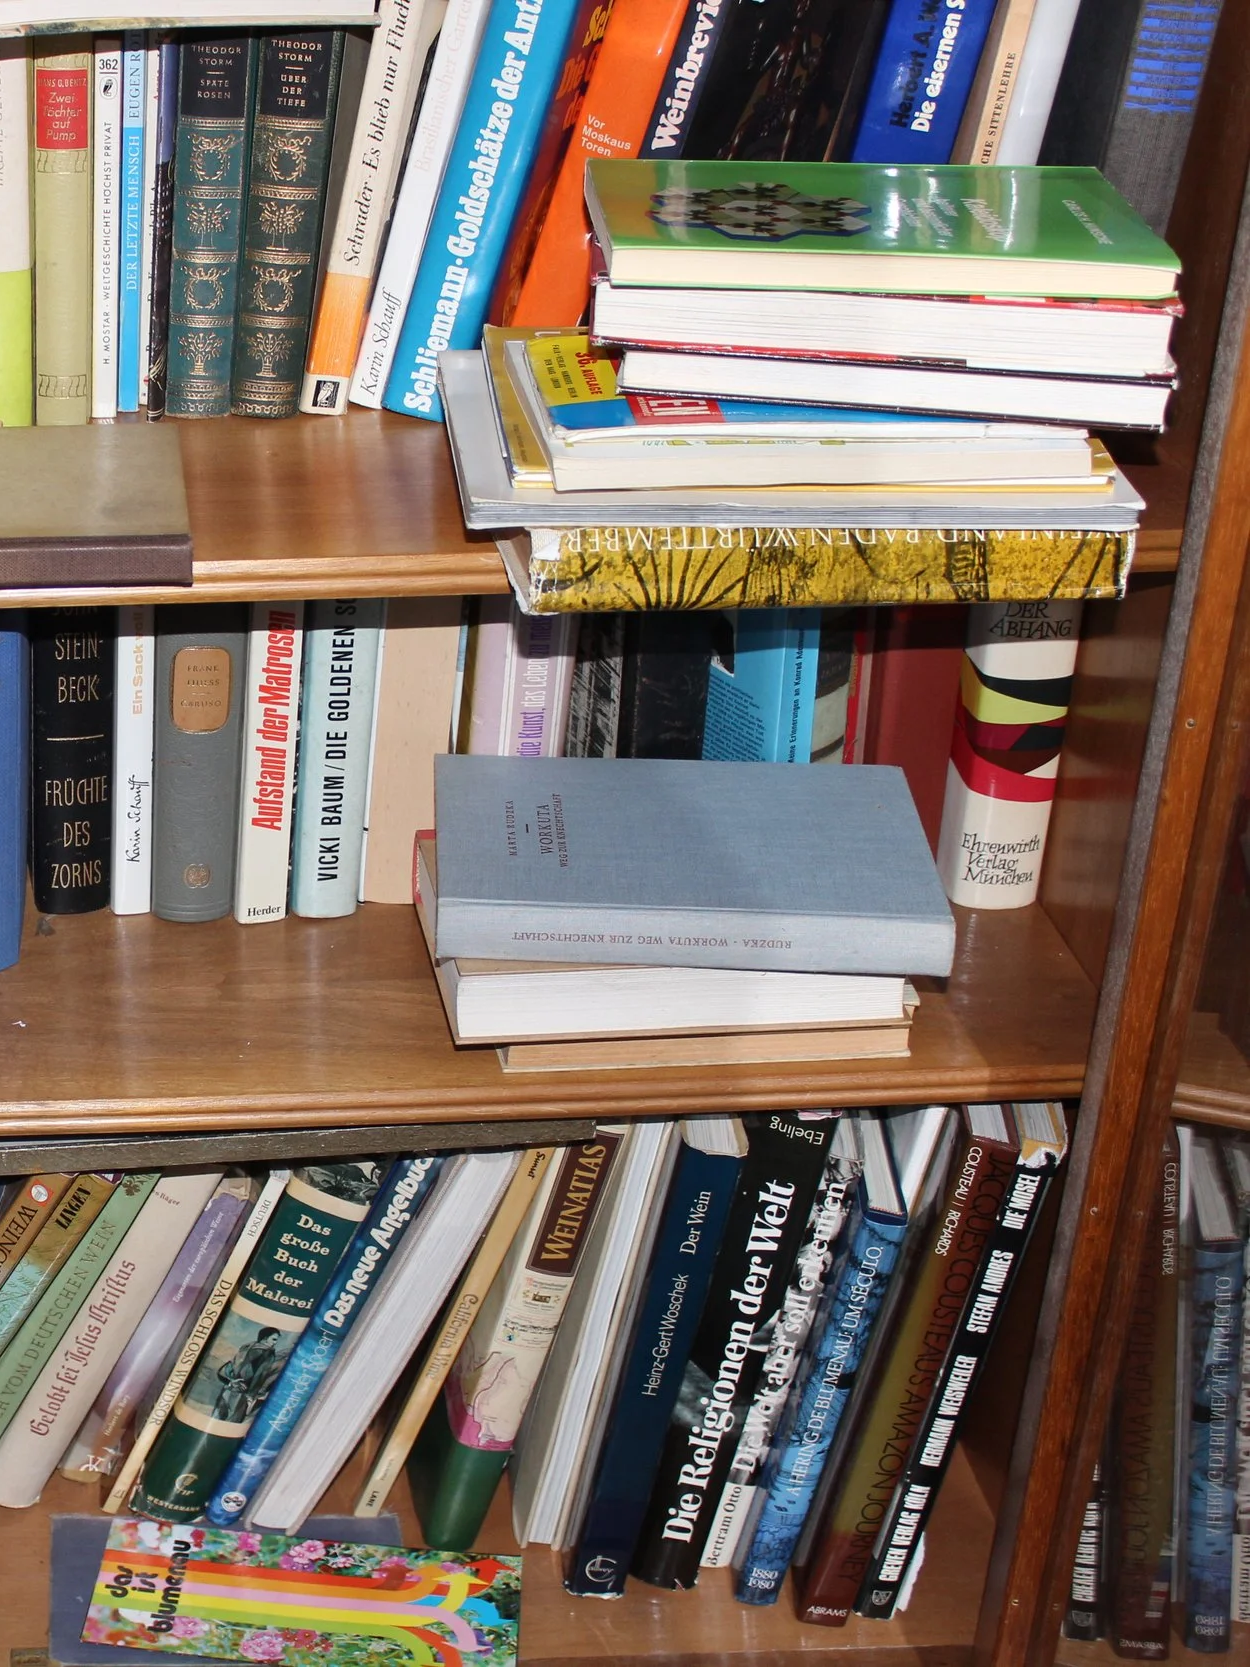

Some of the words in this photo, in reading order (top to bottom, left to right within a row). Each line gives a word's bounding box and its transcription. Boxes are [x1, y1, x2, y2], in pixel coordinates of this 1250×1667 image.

[191, 45, 242, 55] THEODOR
[271, 40, 322, 51] THEODOR
[278, 52, 312, 63] STORM
[99, 59, 118, 70] 362
[199, 57, 234, 66] STORM
[911, 101, 936, 133] Die
[925, 18, 958, 98] eisernen
[128, 67, 141, 119] EUGEN
[200, 77, 230, 88] SPÄTE
[280, 73, 307, 84] ÜBER
[282, 85, 302, 95] DER
[197, 90, 231, 99] ROSEN
[276, 97, 306, 107] TIEFE
[46, 130, 77, 142] Pump
[588, 115, 605, 130] Vor
[104, 122, 112, 156] PRIVAT
[581, 137, 611, 157] Toren
[582, 127, 631, 150] Moskaus
[128, 135, 140, 197] MENSCH
[104, 160, 112, 204] HÖCHST
[126, 201, 140, 257] LETZTE
[103, 207, 112, 300] WELTGESCHICHTE
[126, 260, 138, 291] DER
[103, 311, 111, 352] MOSTAR
[360, 350, 384, 396] Karin
[372, 287, 402, 348] Schauff
[1004, 602, 1050, 619] DER
[990, 618, 1072, 638] ABHANG
[55, 633, 104, 660] STEIN-
[258, 610, 297, 708] Matrosen
[187, 664, 219, 673] FRANK
[328, 627, 355, 722] GOLDENEN
[58, 674, 100, 703] BECK
[180, 700, 222, 708] CARUSO
[256, 709, 289, 743] der
[325, 731, 347, 760] DIE
[45, 775, 108, 807] FRÜCHTE
[251, 746, 286, 832] Aufstand
[321, 776, 345, 826] BAUM
[63, 821, 91, 848] DES
[541, 803, 553, 855] WORKUTA
[960, 832, 1040, 855] Ehrenwirth
[317, 837, 340, 882] VICKI
[966, 852, 1019, 872] Verlag
[51, 860, 102, 889] ZORNS
[961, 866, 1034, 886] München
[247, 904, 282, 917] Herder
[512, 931, 605, 943] KNECHTSCHAFT
[609, 934, 633, 944] ZUR
[637, 935, 663, 945] WEG
[669, 935, 728, 948] WORKUTA
[743, 939, 792, 949] RUDZKA
[769, 1115, 825, 1146] Ebeling
[953, 1146, 983, 1201] COUSTEAU
[540, 1143, 608, 1261] WEINATLAS
[1006, 1173, 1042, 1208] MOSEL
[247, 1199, 272, 1239] DEUTSCH
[687, 1189, 712, 1226] Wein
[746, 1179, 797, 1254] Welt
[1002, 1210, 1025, 1231] DIE
[297, 1214, 332, 1236] Das
[935, 1208, 963, 1257] RICHARDS
[279, 1230, 331, 1256] große
[680, 1226, 700, 1256] Der
[273, 1248, 319, 1273] Buch
[214, 1279, 233, 1305] DAS
[273, 1270, 303, 1288] der
[730, 1256, 772, 1317] der
[967, 1294, 999, 1334] STEFAN
[989, 1250, 1014, 1296] ANDRES
[3, 1361, 31, 1397] VOM
[24, 1270, 85, 1360] DEUTSCHEN
[80, 1220, 117, 1268] WEIN
[245, 1278, 313, 1310] Malerei
[180, 1303, 220, 1368] SCHLOSS
[268, 1367, 312, 1432] Alexander
[303, 1327, 335, 1372] Spoerl
[937, 1355, 979, 1417] WEISWEILER
[149, 1365, 190, 1426] WINDSOR
[678, 1318, 754, 1490] Religionen
[920, 1419, 956, 1468] HERMANN
[147, 1495, 203, 1514] WESTERMANN
[662, 1492, 704, 1543] Die
[706, 1514, 737, 1566] Bertram
[724, 1486, 743, 1516] Otto
[110, 1566, 134, 1598] das
[131, 1570, 158, 1595] ist
[147, 1540, 191, 1633] blumenau
[747, 1577, 775, 1590] 1980
[751, 1567, 778, 1580] 1880
[806, 1604, 848, 1618] ABRAMS
